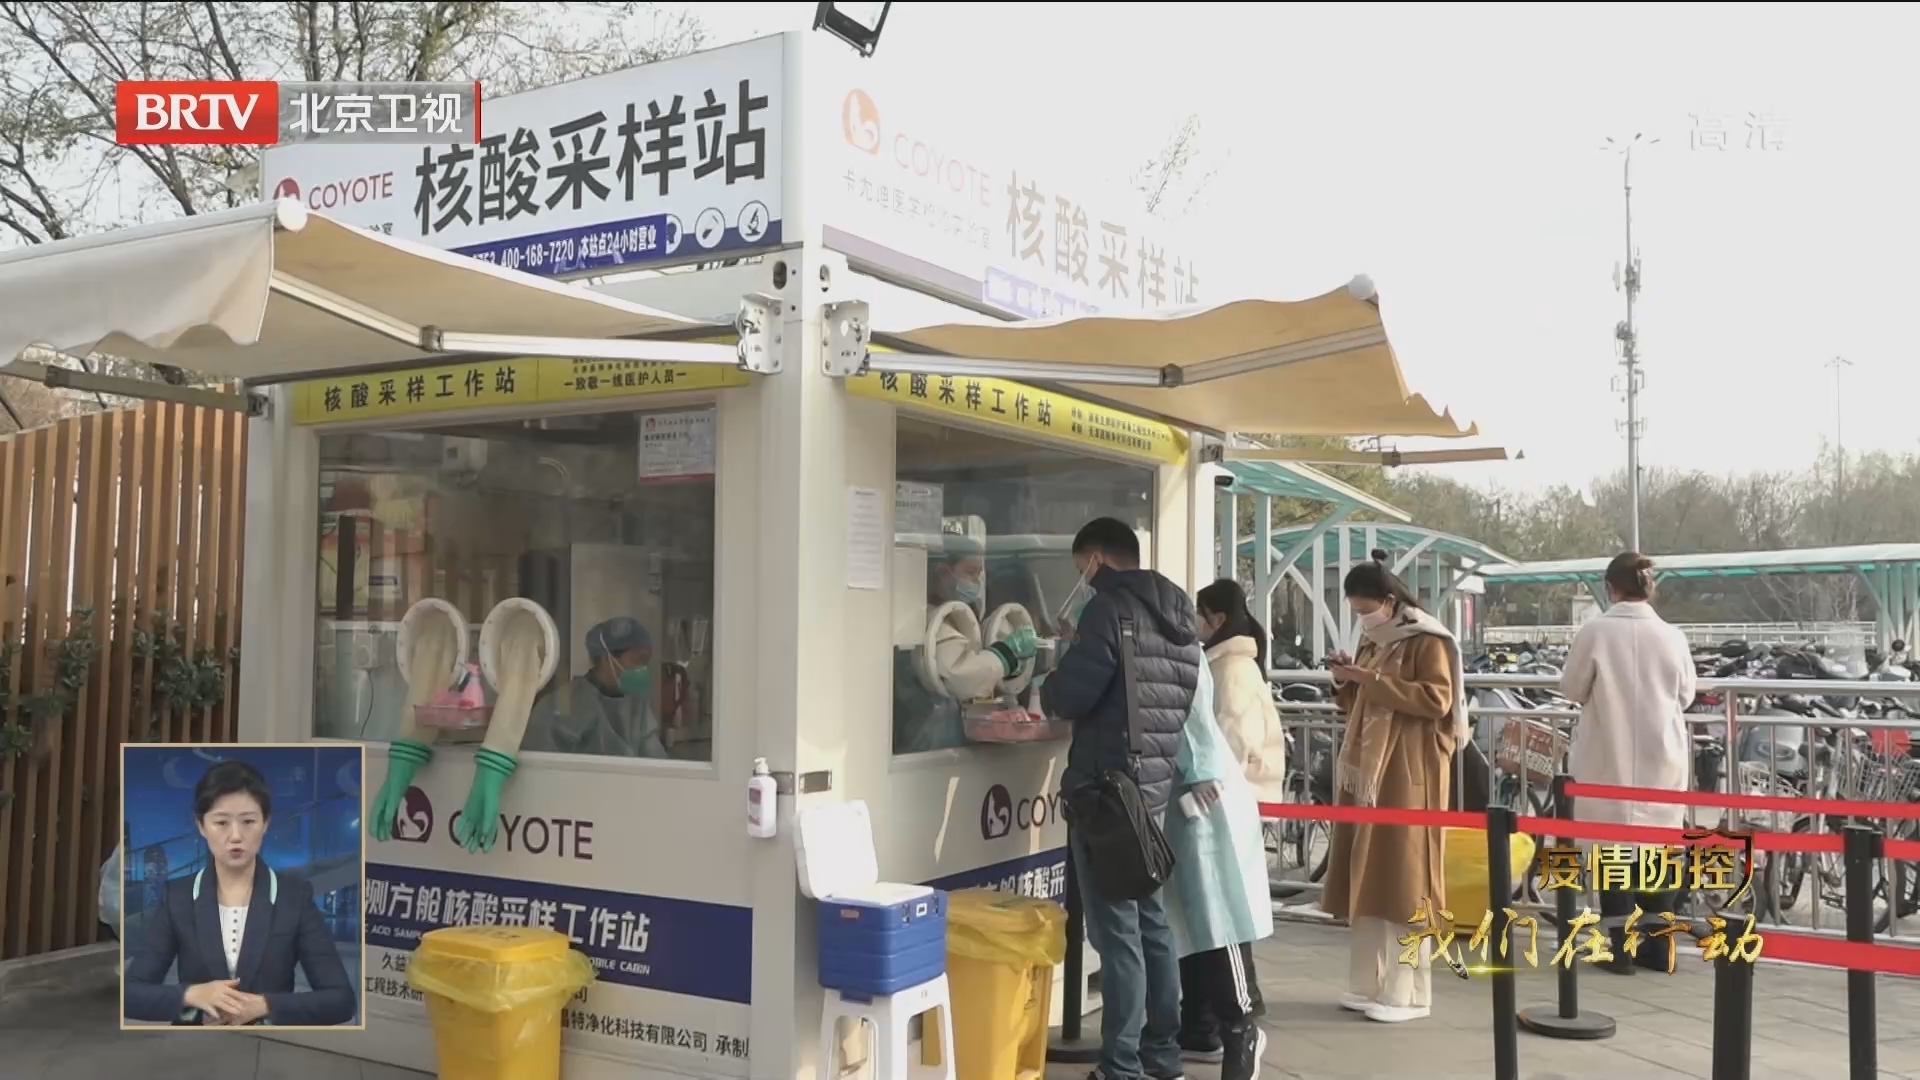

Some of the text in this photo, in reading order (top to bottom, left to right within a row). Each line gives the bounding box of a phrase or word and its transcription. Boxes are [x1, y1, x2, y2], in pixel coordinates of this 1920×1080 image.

[414, 79, 769, 236] 核酸采样站
[893, 132, 991, 208] COYOTE
[308, 171, 394, 210] COYOTE
[580, 225, 657, 259] 本站点24小时营业
[1006, 169, 1199, 309] 核酸采样站
[324, 366, 516, 412] 核酸采样工作站
[880, 371, 1051, 426] 核酸采样工作站
[448, 810, 593, 860] CYOTE
[716, 1034, 749, 1058] 承制
